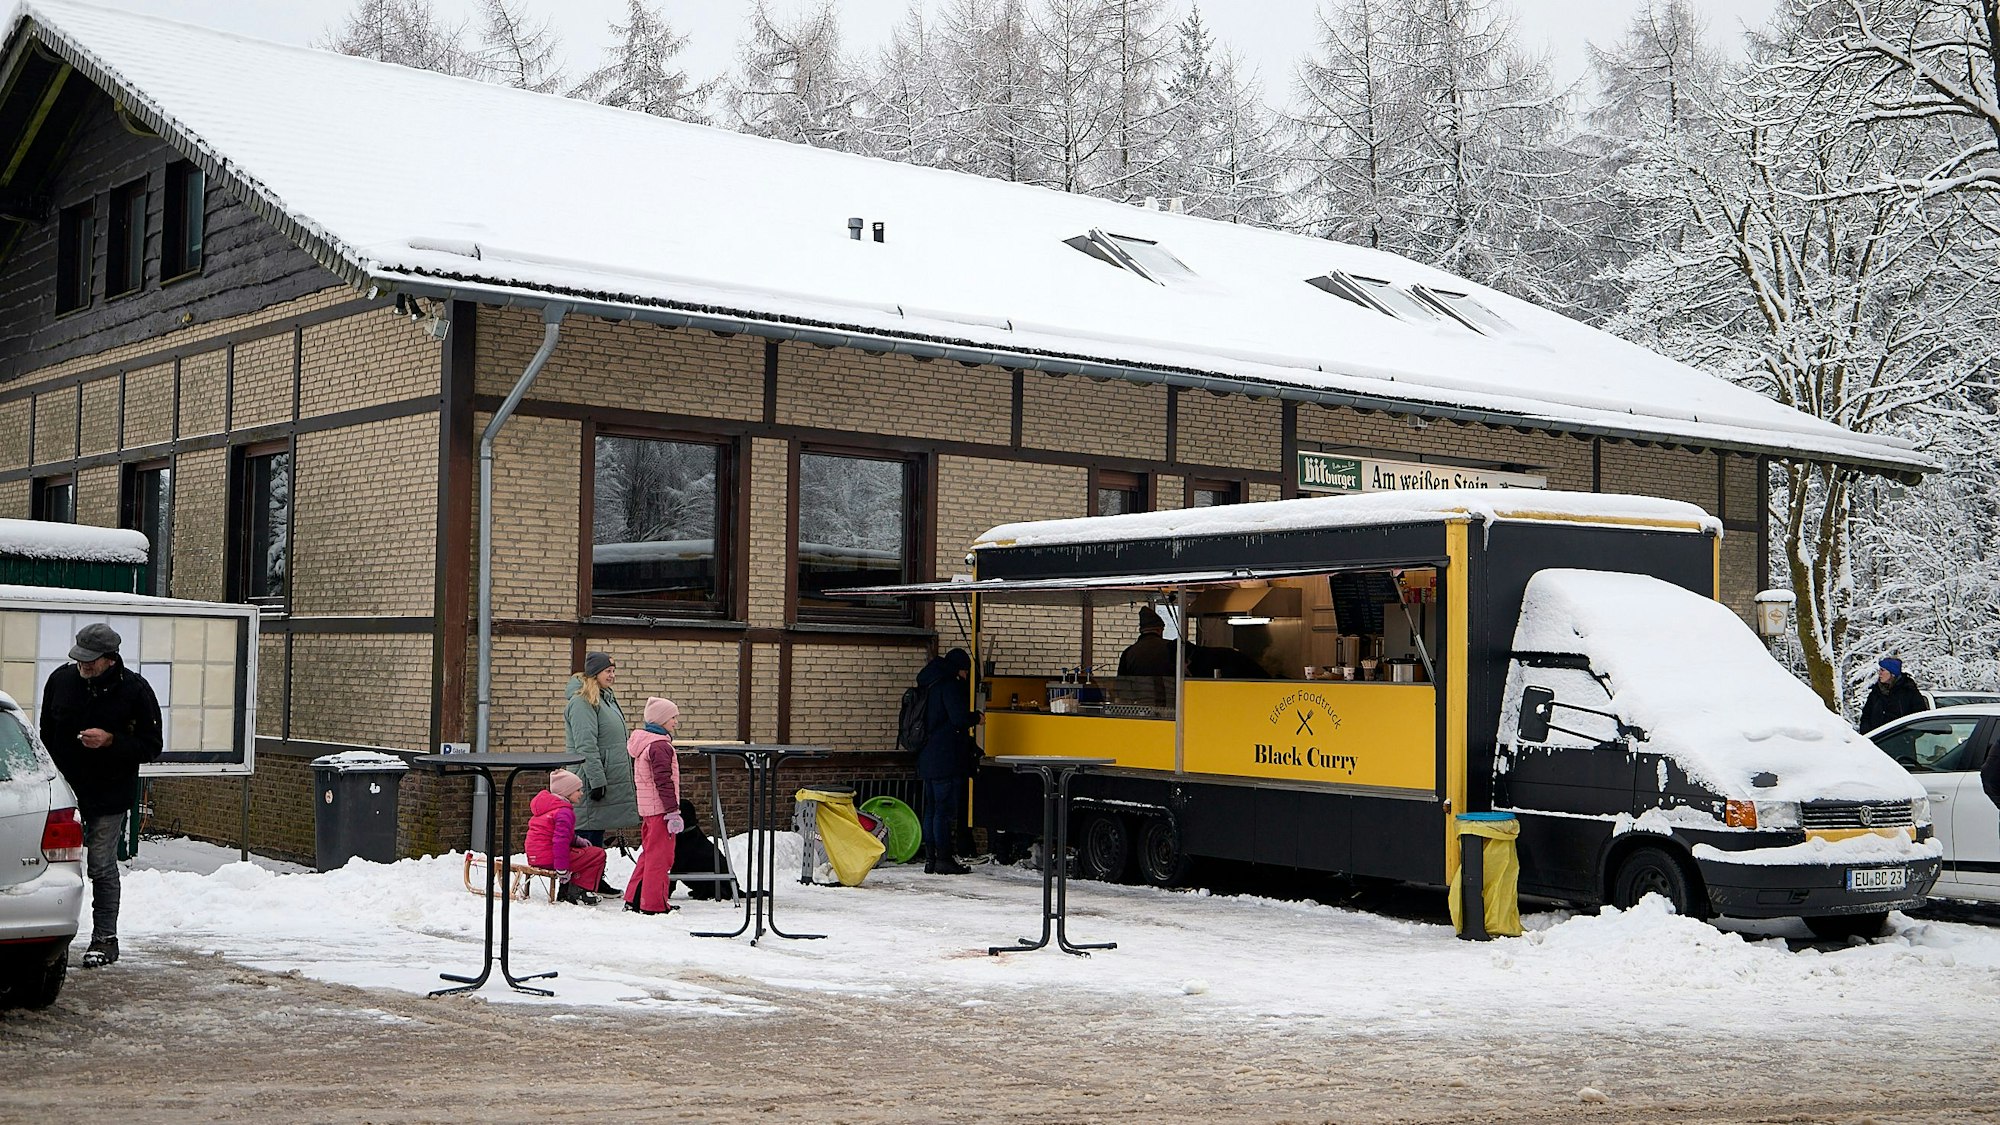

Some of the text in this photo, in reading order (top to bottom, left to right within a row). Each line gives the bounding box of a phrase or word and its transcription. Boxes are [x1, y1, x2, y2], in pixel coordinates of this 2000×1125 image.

[1304, 457, 1356, 490] Bitburger
[1372, 465, 1396, 490] Am
[1400, 470, 1449, 490] weißen
[1269, 689, 1342, 730] Eifeler Foodtruck
[1254, 743, 1359, 776] Black Curry
[1855, 870, 1902, 887] EU BC 23
